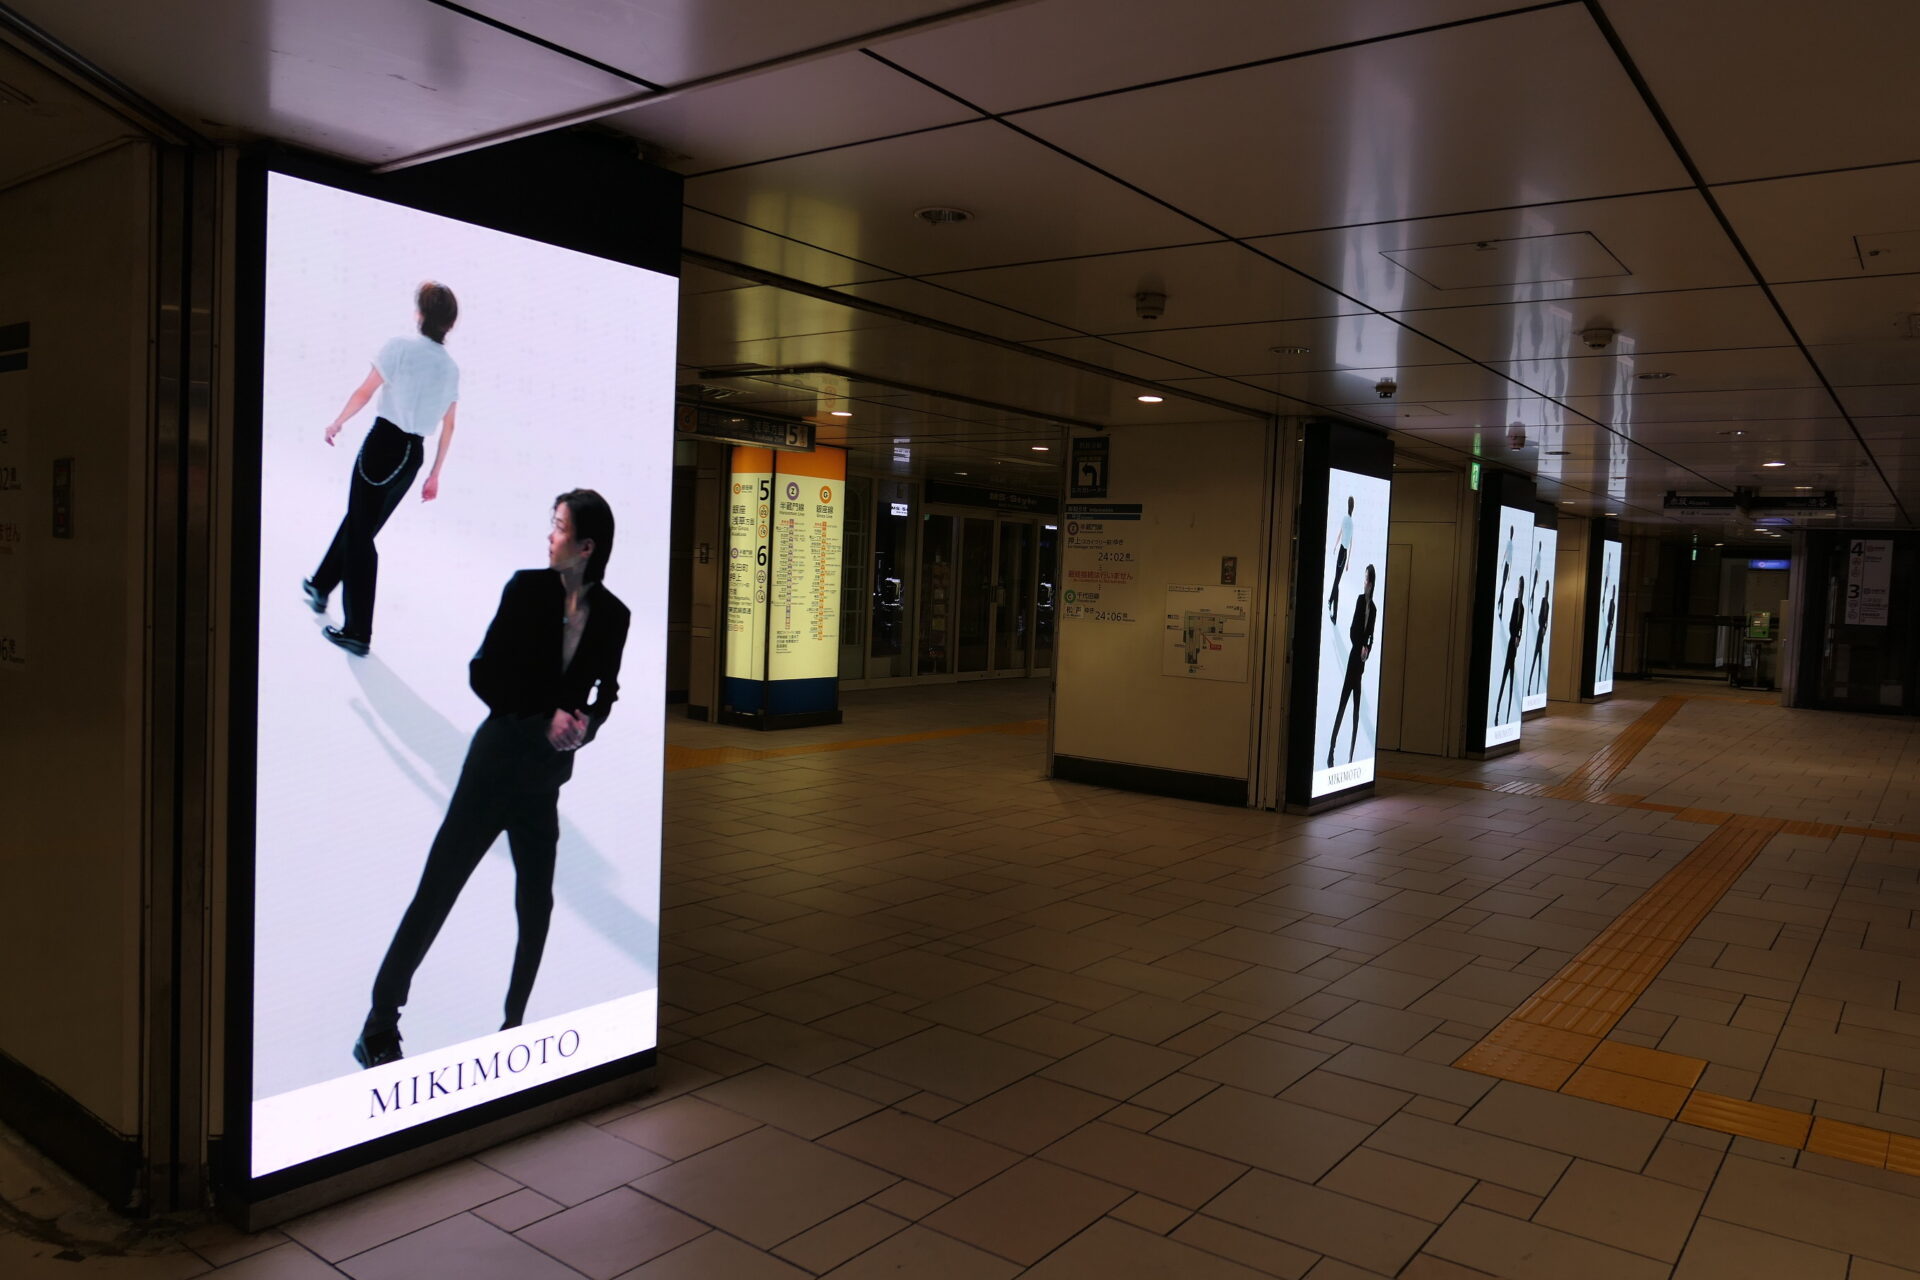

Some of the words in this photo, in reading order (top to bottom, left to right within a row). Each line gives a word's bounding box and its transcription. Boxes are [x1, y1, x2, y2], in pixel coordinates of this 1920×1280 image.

[790, 425, 798, 445] 5
[759, 480, 770, 501] 5
[732, 504, 746, 515] 銀座
[780, 501, 805, 512] 半蔵門線
[816, 504, 834, 514] 銀座線
[757, 545, 767, 566] 6
[1851, 541, 1864, 557] 4
[1098, 552, 1125, 562] 24:02
[1077, 592, 1100, 600] 千代田線
[1847, 584, 1860, 599] 3
[1095, 611, 1122, 622] 24:06
[1328, 767, 1362, 787] MIKIMOTO
[369, 1029, 580, 1119] MIKIMOTO
